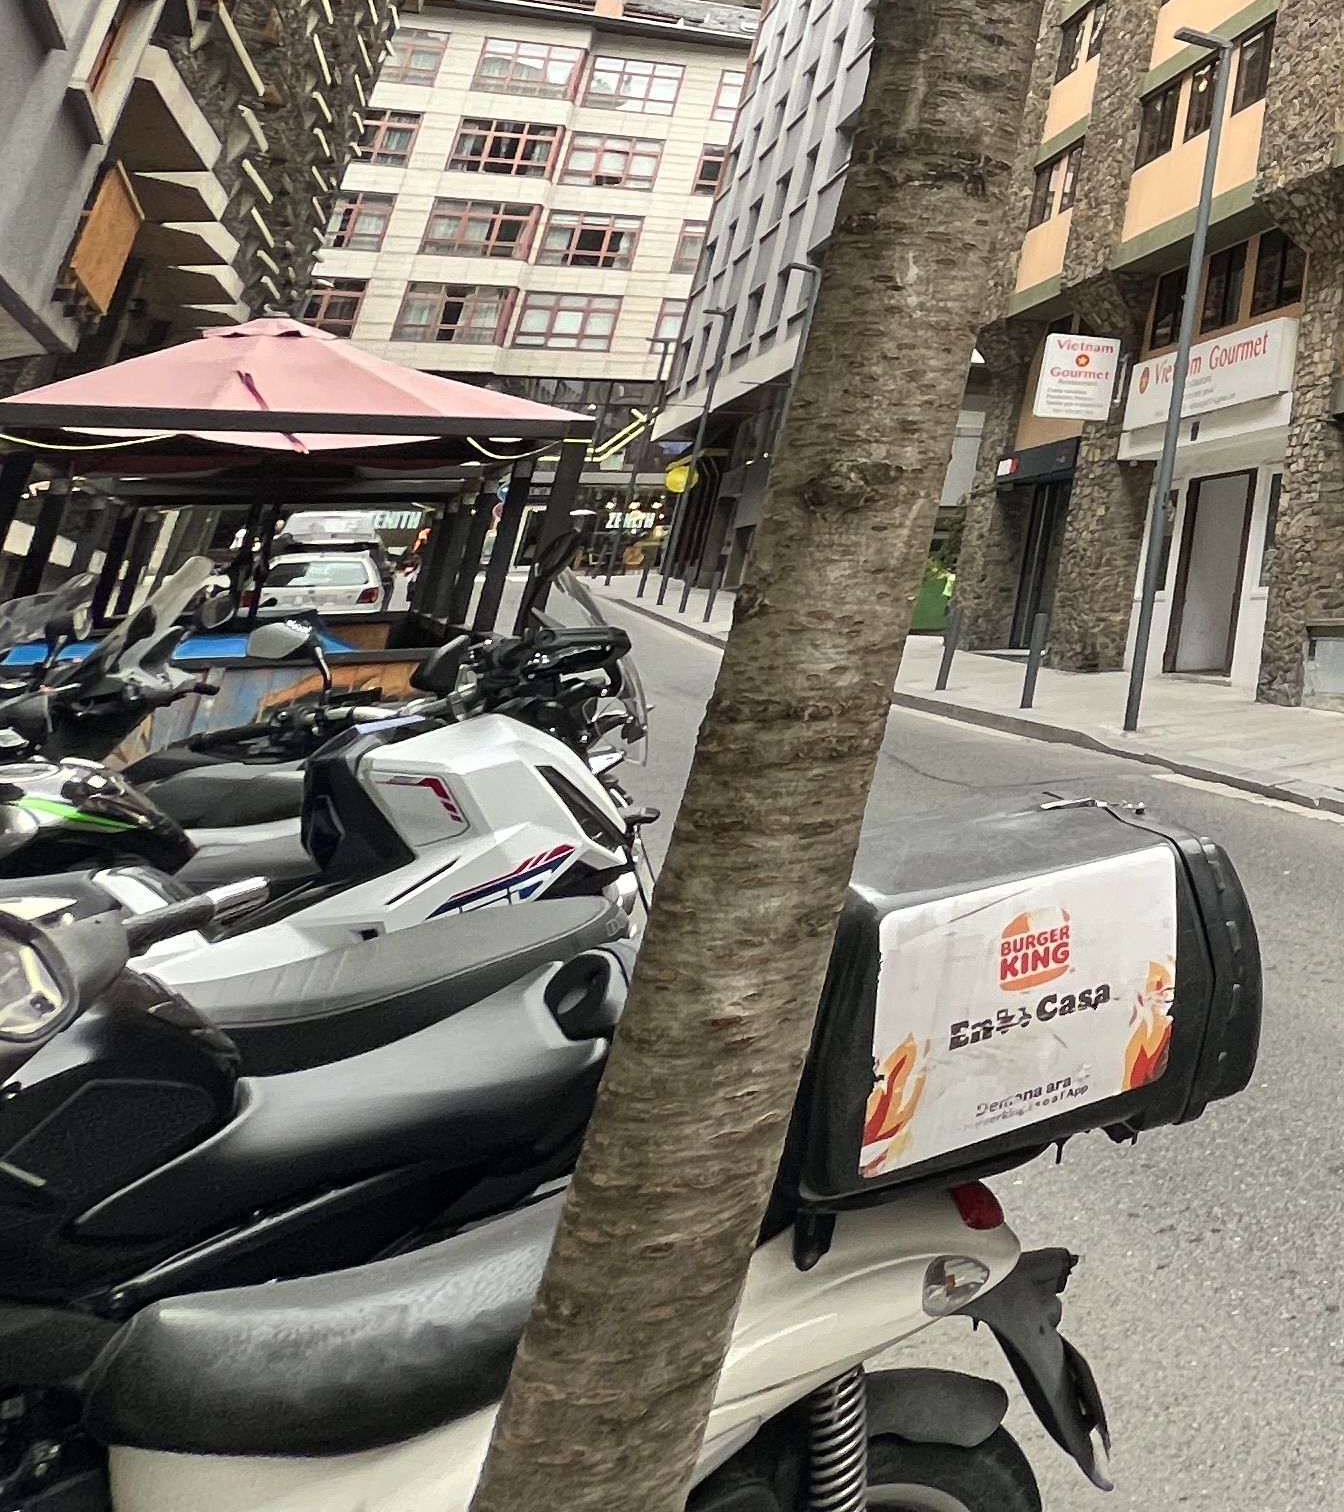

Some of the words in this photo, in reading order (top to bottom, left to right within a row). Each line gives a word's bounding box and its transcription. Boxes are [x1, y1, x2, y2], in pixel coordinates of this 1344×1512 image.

[1056, 338, 1114, 354] Vietnam
[1154, 355, 1202, 385] Viem
[1209, 330, 1269, 370] Gourmet
[1050, 366, 1109, 380] Gourmet
[1000, 925, 1070, 957] BURGER
[1000, 941, 1070, 981] KING
[1036, 984, 1111, 1022] Casa
[1046, 1076, 1072, 1094] ara
